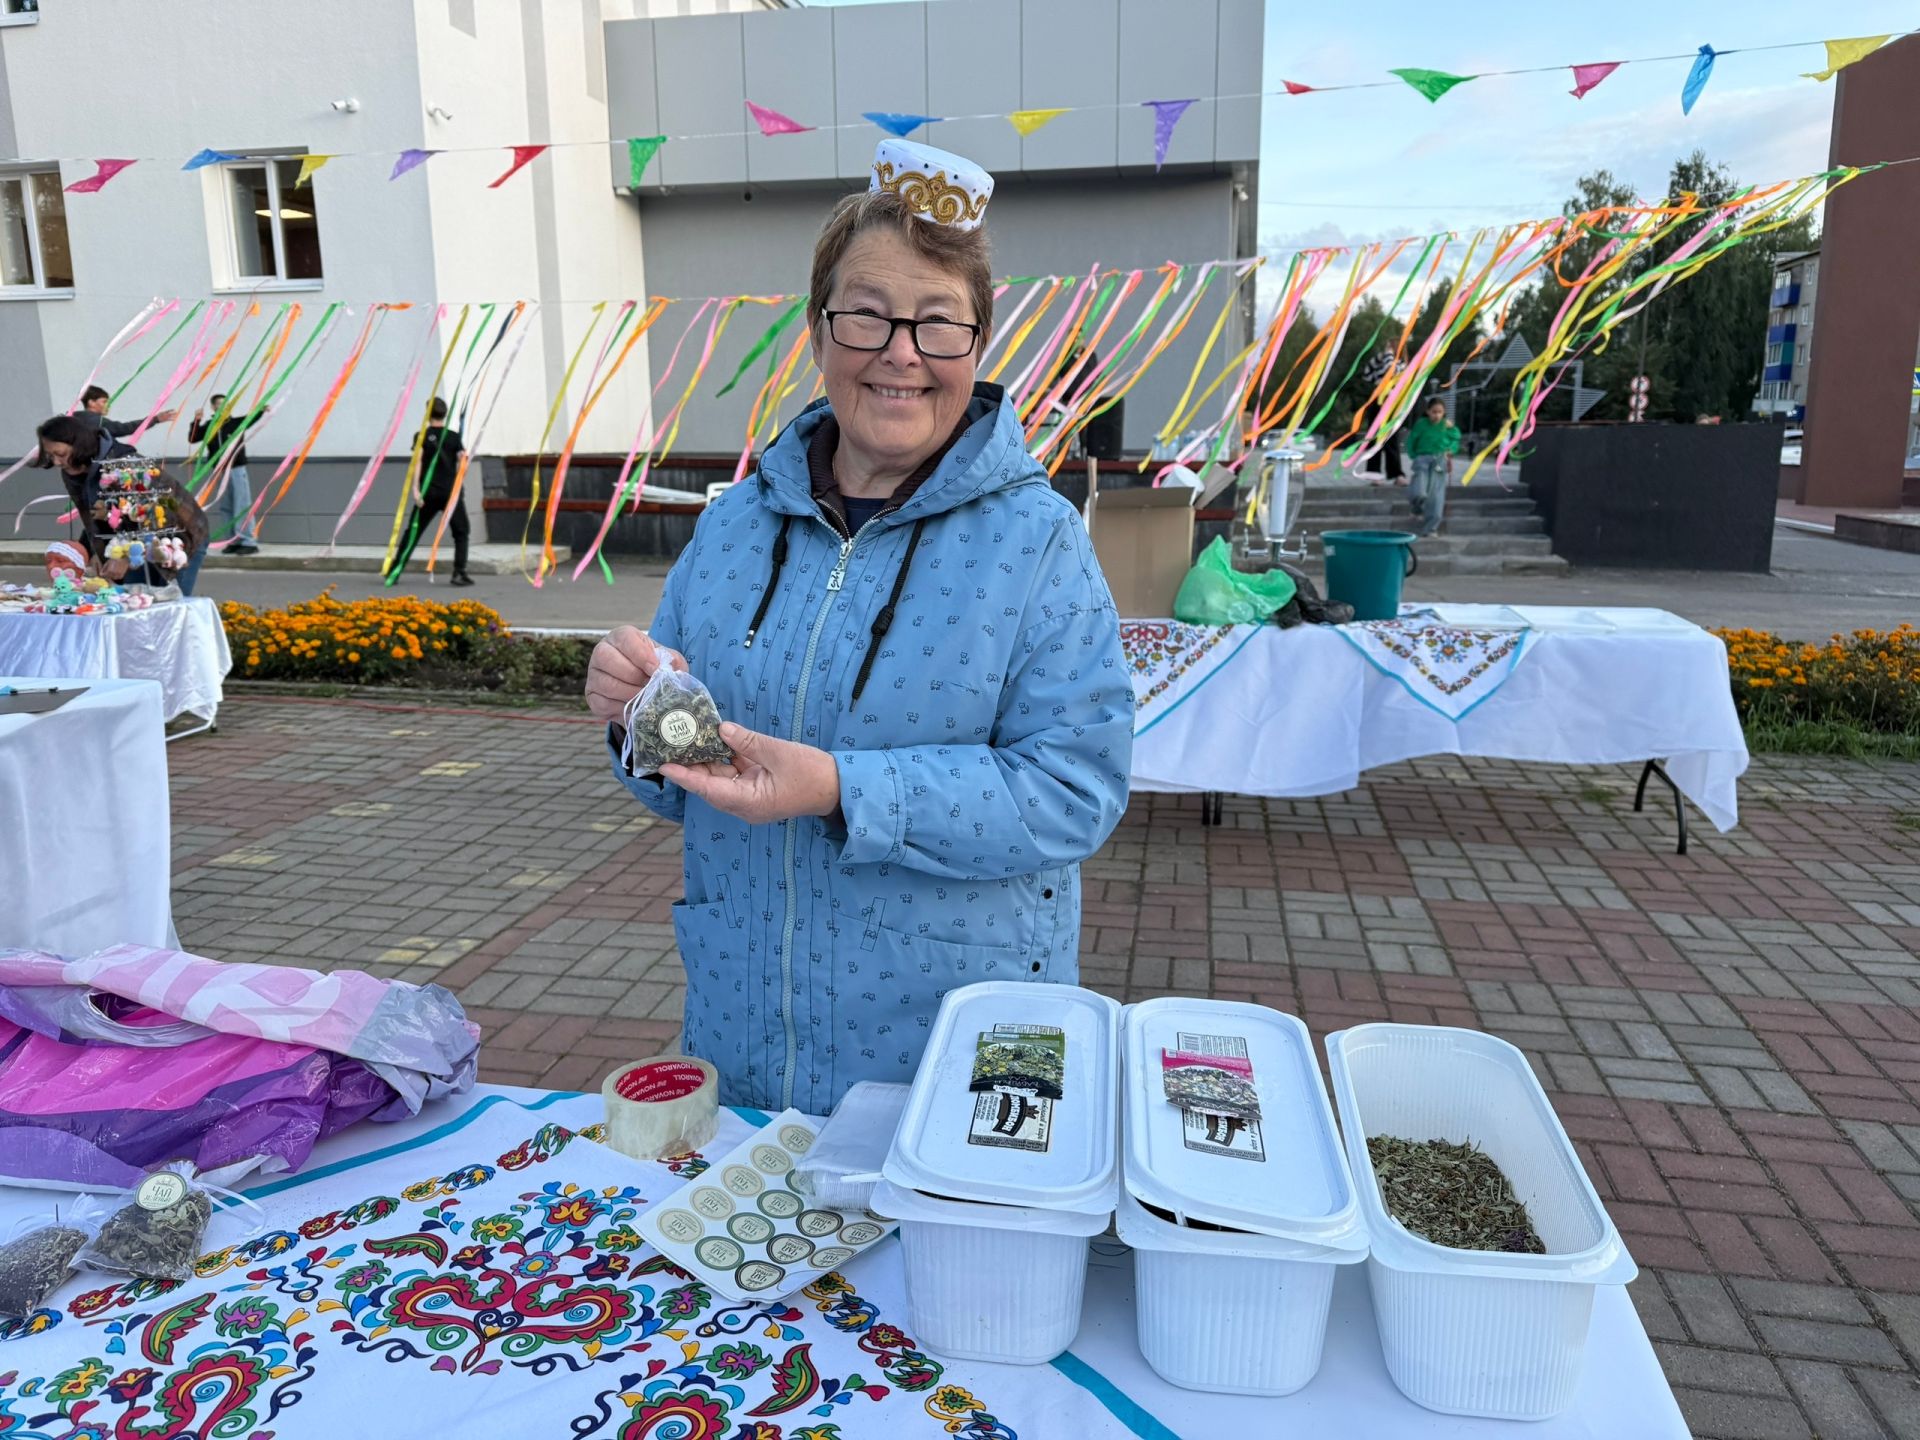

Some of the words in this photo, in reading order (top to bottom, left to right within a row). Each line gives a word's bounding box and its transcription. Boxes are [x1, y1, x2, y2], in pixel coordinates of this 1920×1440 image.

[669, 721, 688, 733] ЧАЙ
[653, 1063, 691, 1073] NOVAROLL
[152, 1185, 172, 1198] ЧАЙ
